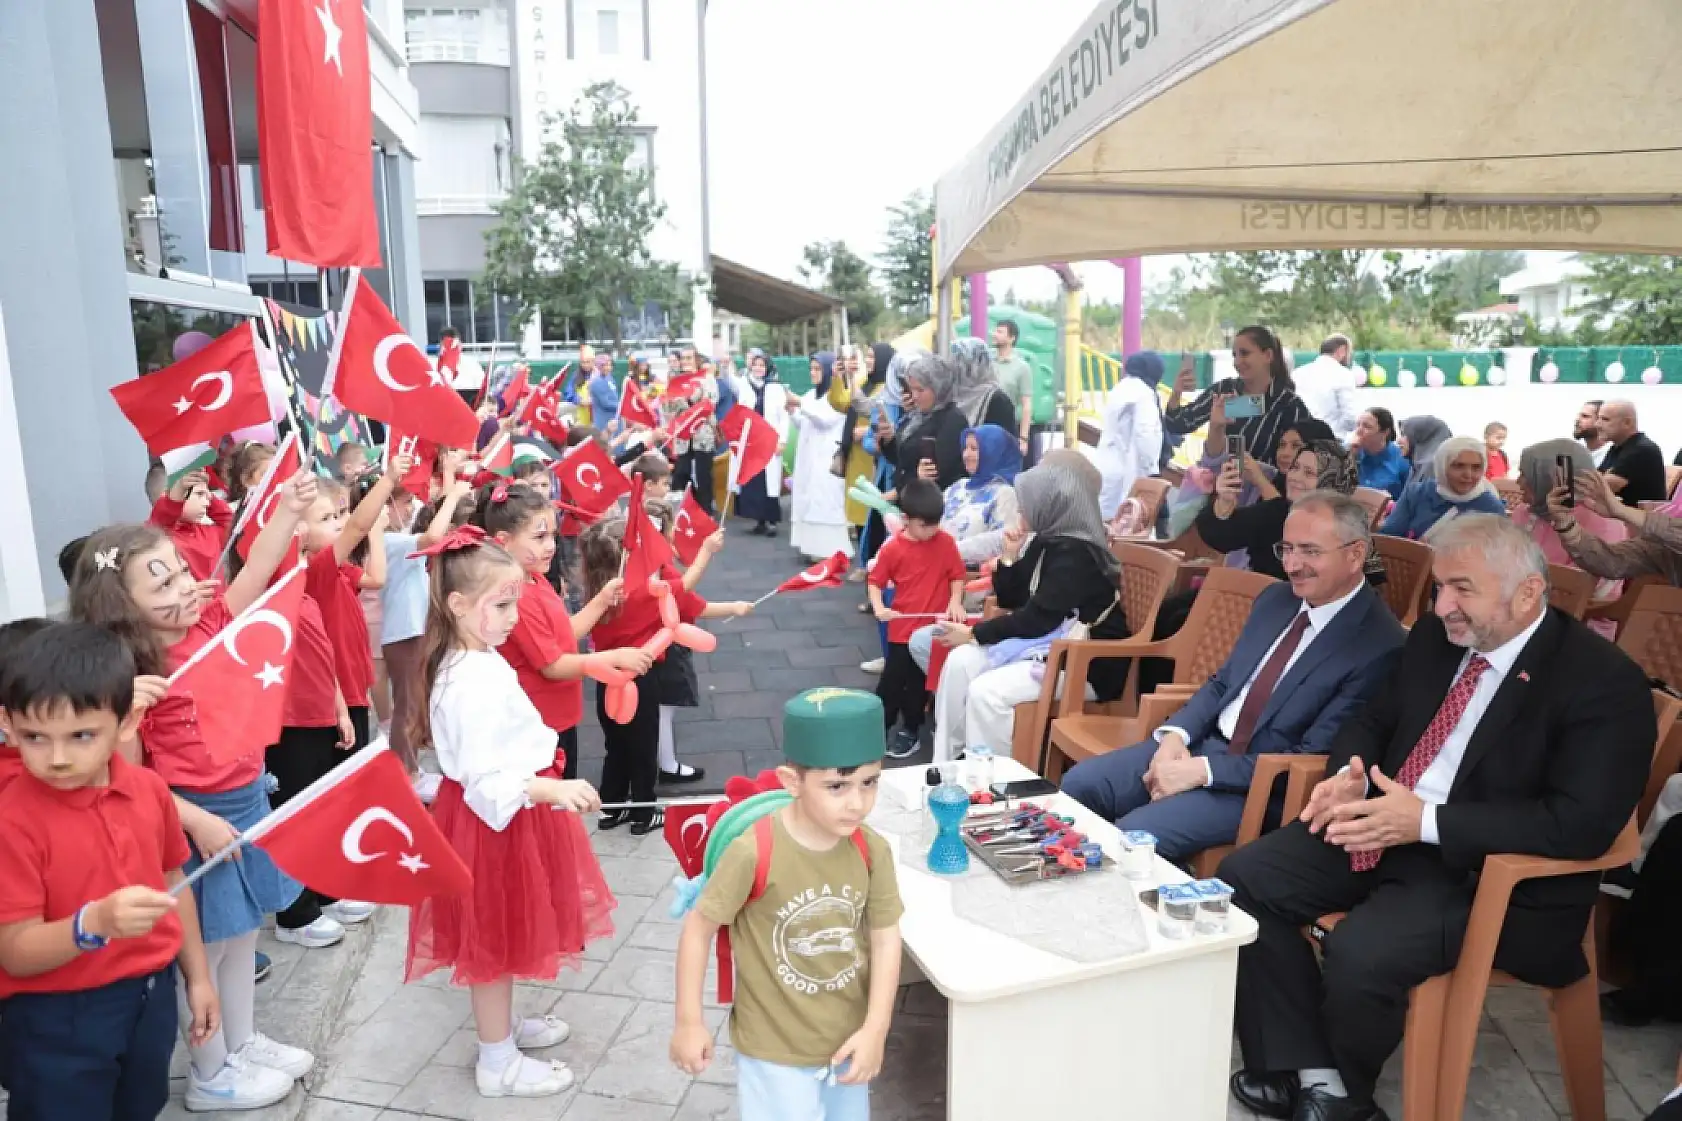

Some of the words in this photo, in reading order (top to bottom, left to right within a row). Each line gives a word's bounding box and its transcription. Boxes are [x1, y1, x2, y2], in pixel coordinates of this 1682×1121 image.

[777, 888, 816, 918] HAVE
[821, 883, 832, 896] A
[777, 964, 818, 994] GOOD
